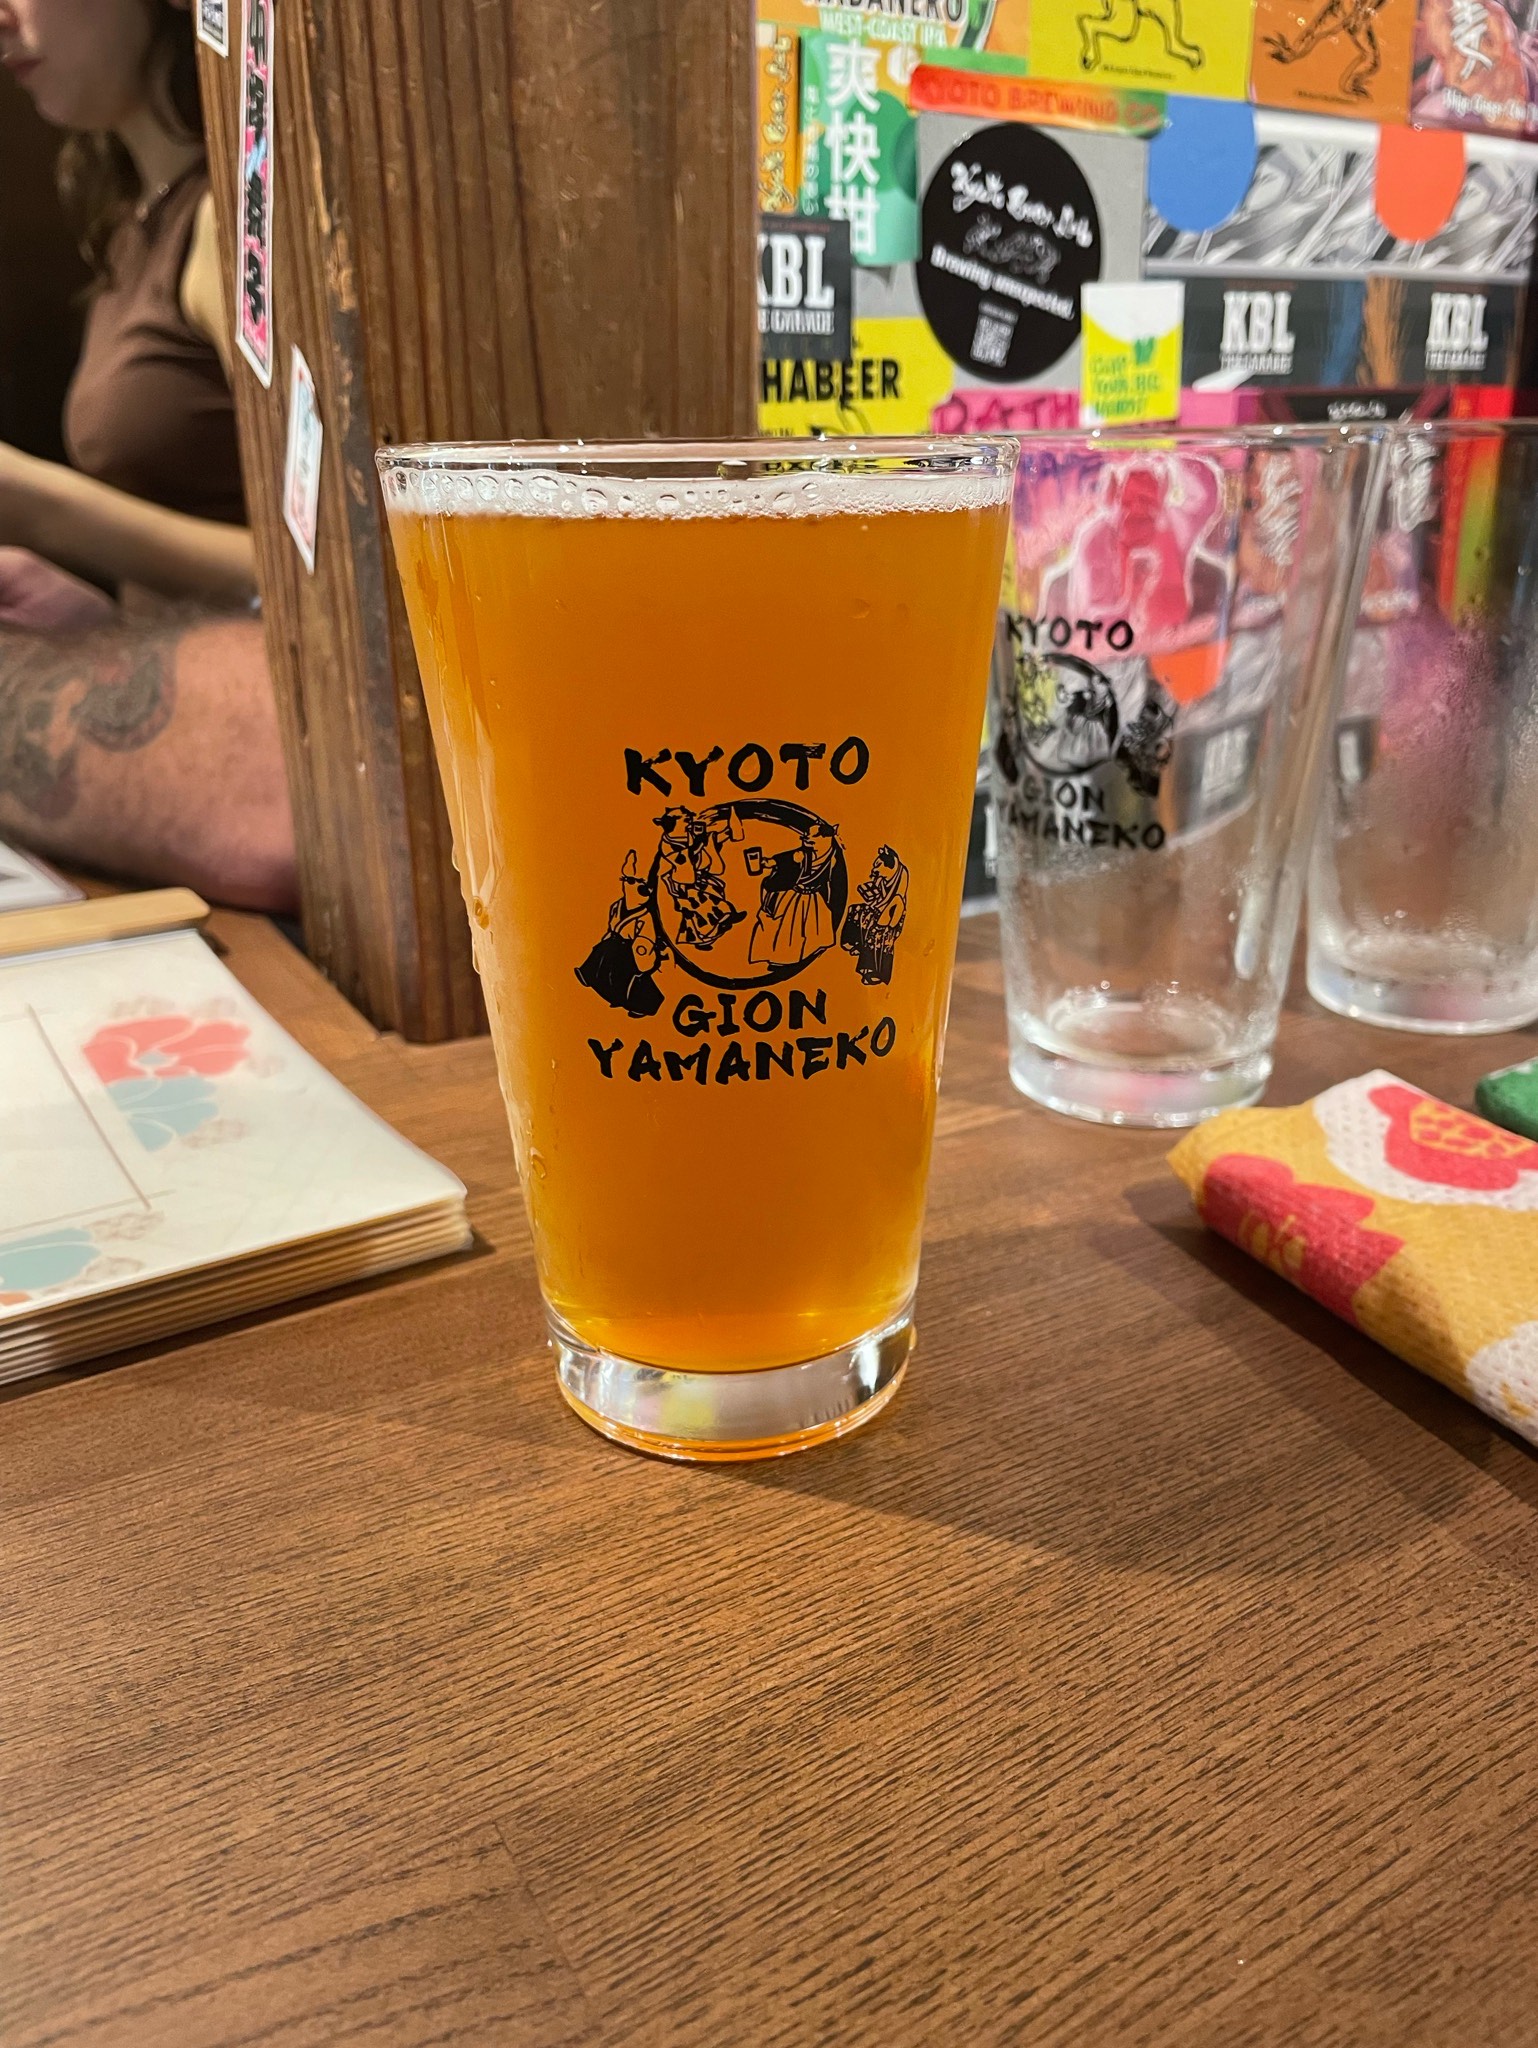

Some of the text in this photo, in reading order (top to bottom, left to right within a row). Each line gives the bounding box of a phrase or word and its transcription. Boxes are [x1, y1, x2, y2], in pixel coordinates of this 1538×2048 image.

[1220, 290, 1295, 353] KBL
[1426, 292, 1488, 353] KBL
[1006, 613, 1134, 651] KYOTO
[623, 736, 870, 797] KYOTO
[1022, 775, 1105, 812] GION
[672, 988, 828, 1038] GION
[587, 1016, 896, 1085] YAMANEKO
